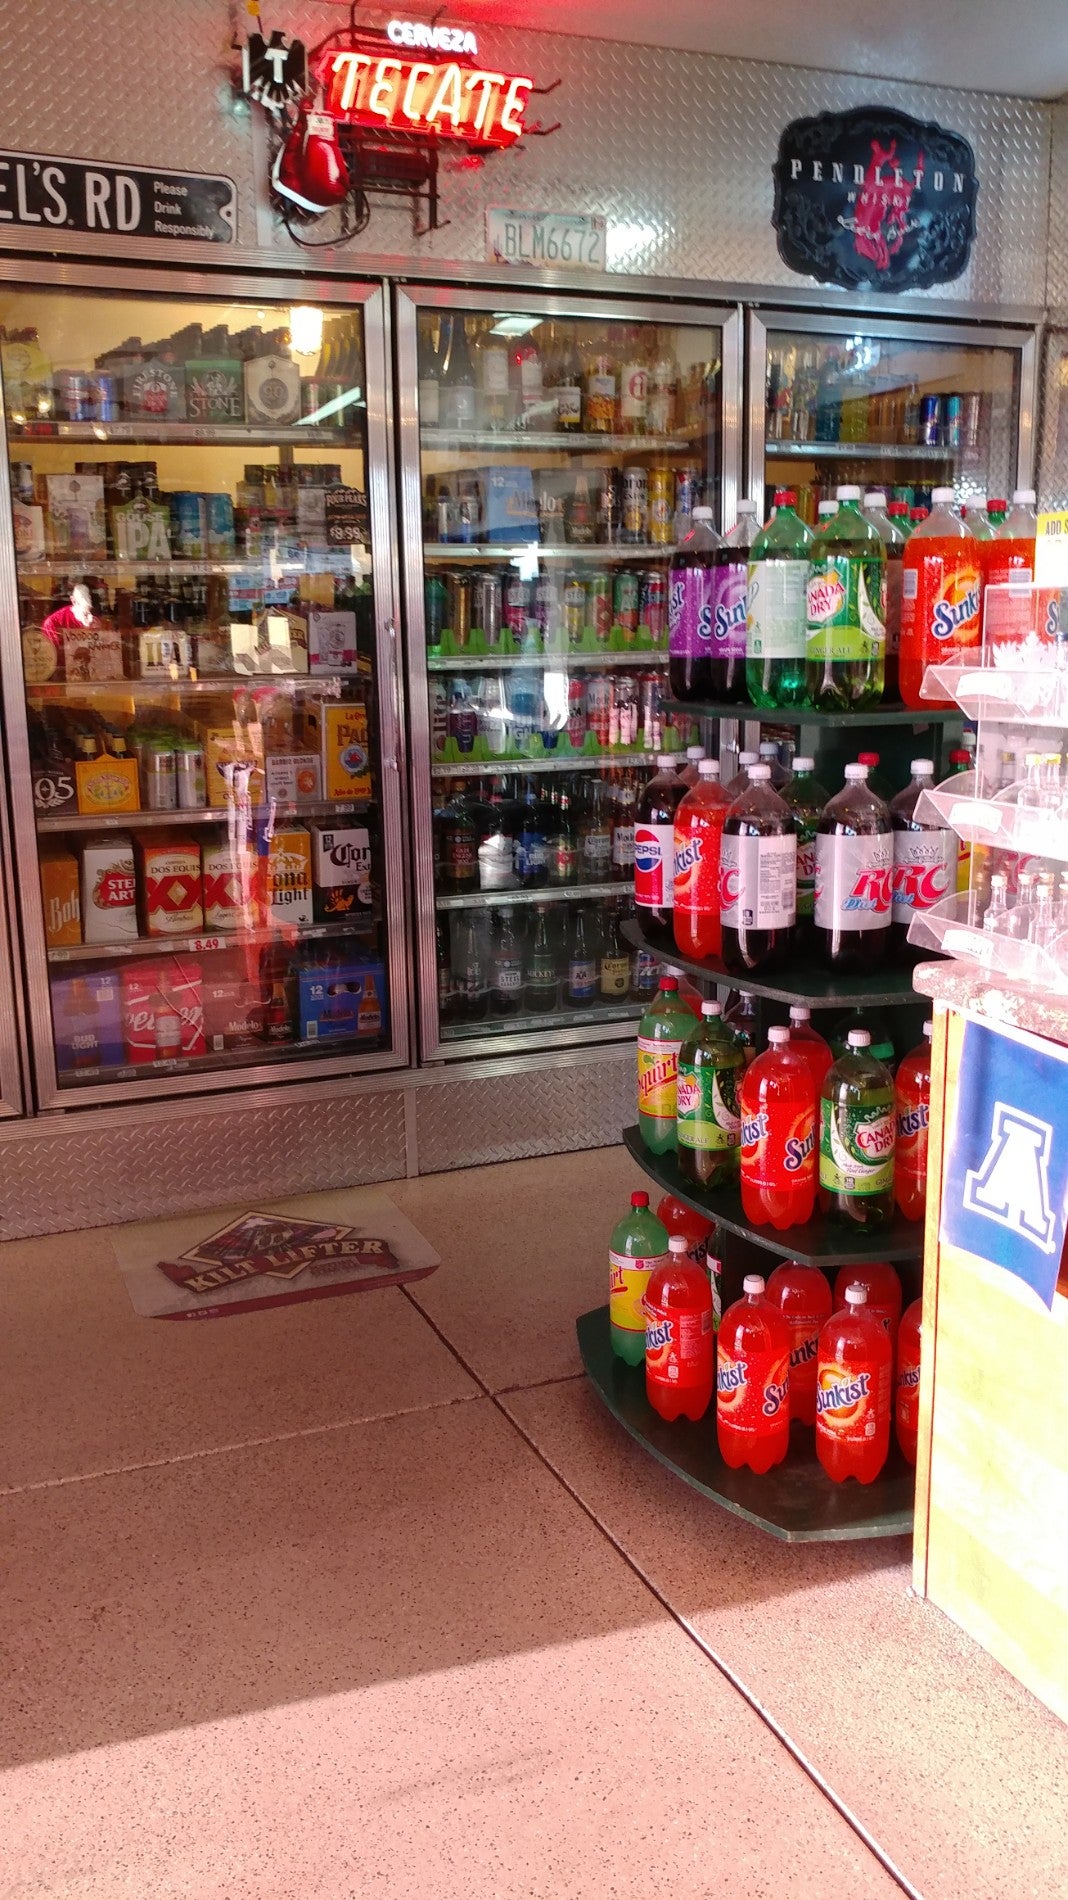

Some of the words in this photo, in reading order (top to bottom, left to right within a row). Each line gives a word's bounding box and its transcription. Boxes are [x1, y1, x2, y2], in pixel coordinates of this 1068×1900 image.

[387, 19, 479, 56] CERVEZA
[330, 51, 535, 136] TECATE
[790, 157, 965, 194] PENDLETON
[153, 181, 188, 197] Please
[85, 171, 142, 231] RD
[154, 201, 182, 216] Drink
[154, 220, 216, 240] Responsibly
[504, 222, 600, 264] BLM6672
[189, 397, 241, 418] STONE
[1046, 520, 1062, 536] ADD
[116, 522, 172, 560] IPA
[810, 601, 834, 616] DRY
[330, 842, 372, 868] Cor
[634, 843, 662, 856] PEPSI
[151, 866, 170, 875] DOS
[172, 864, 201, 873] EQUIS
[208, 863, 225, 871] DOS
[892, 861, 950, 910] RC
[271, 887, 309, 906] Light
[840, 897, 876, 913] Diet
[194, 938, 219, 950] 8.49
[100, 977, 112, 985] 12
[128, 983, 140, 991] 12
[212, 989, 224, 998] 12
[309, 985, 324, 995] 12
[71, 1041, 99, 1050] LIGHT
[73, 1034, 96, 1043] BUD
[963, 1101, 1057, 1254] A
[183, 1258, 261, 1292] KILT
[262, 1239, 385, 1268] LIFTER
[816, 1372, 871, 1414] Sunkist
